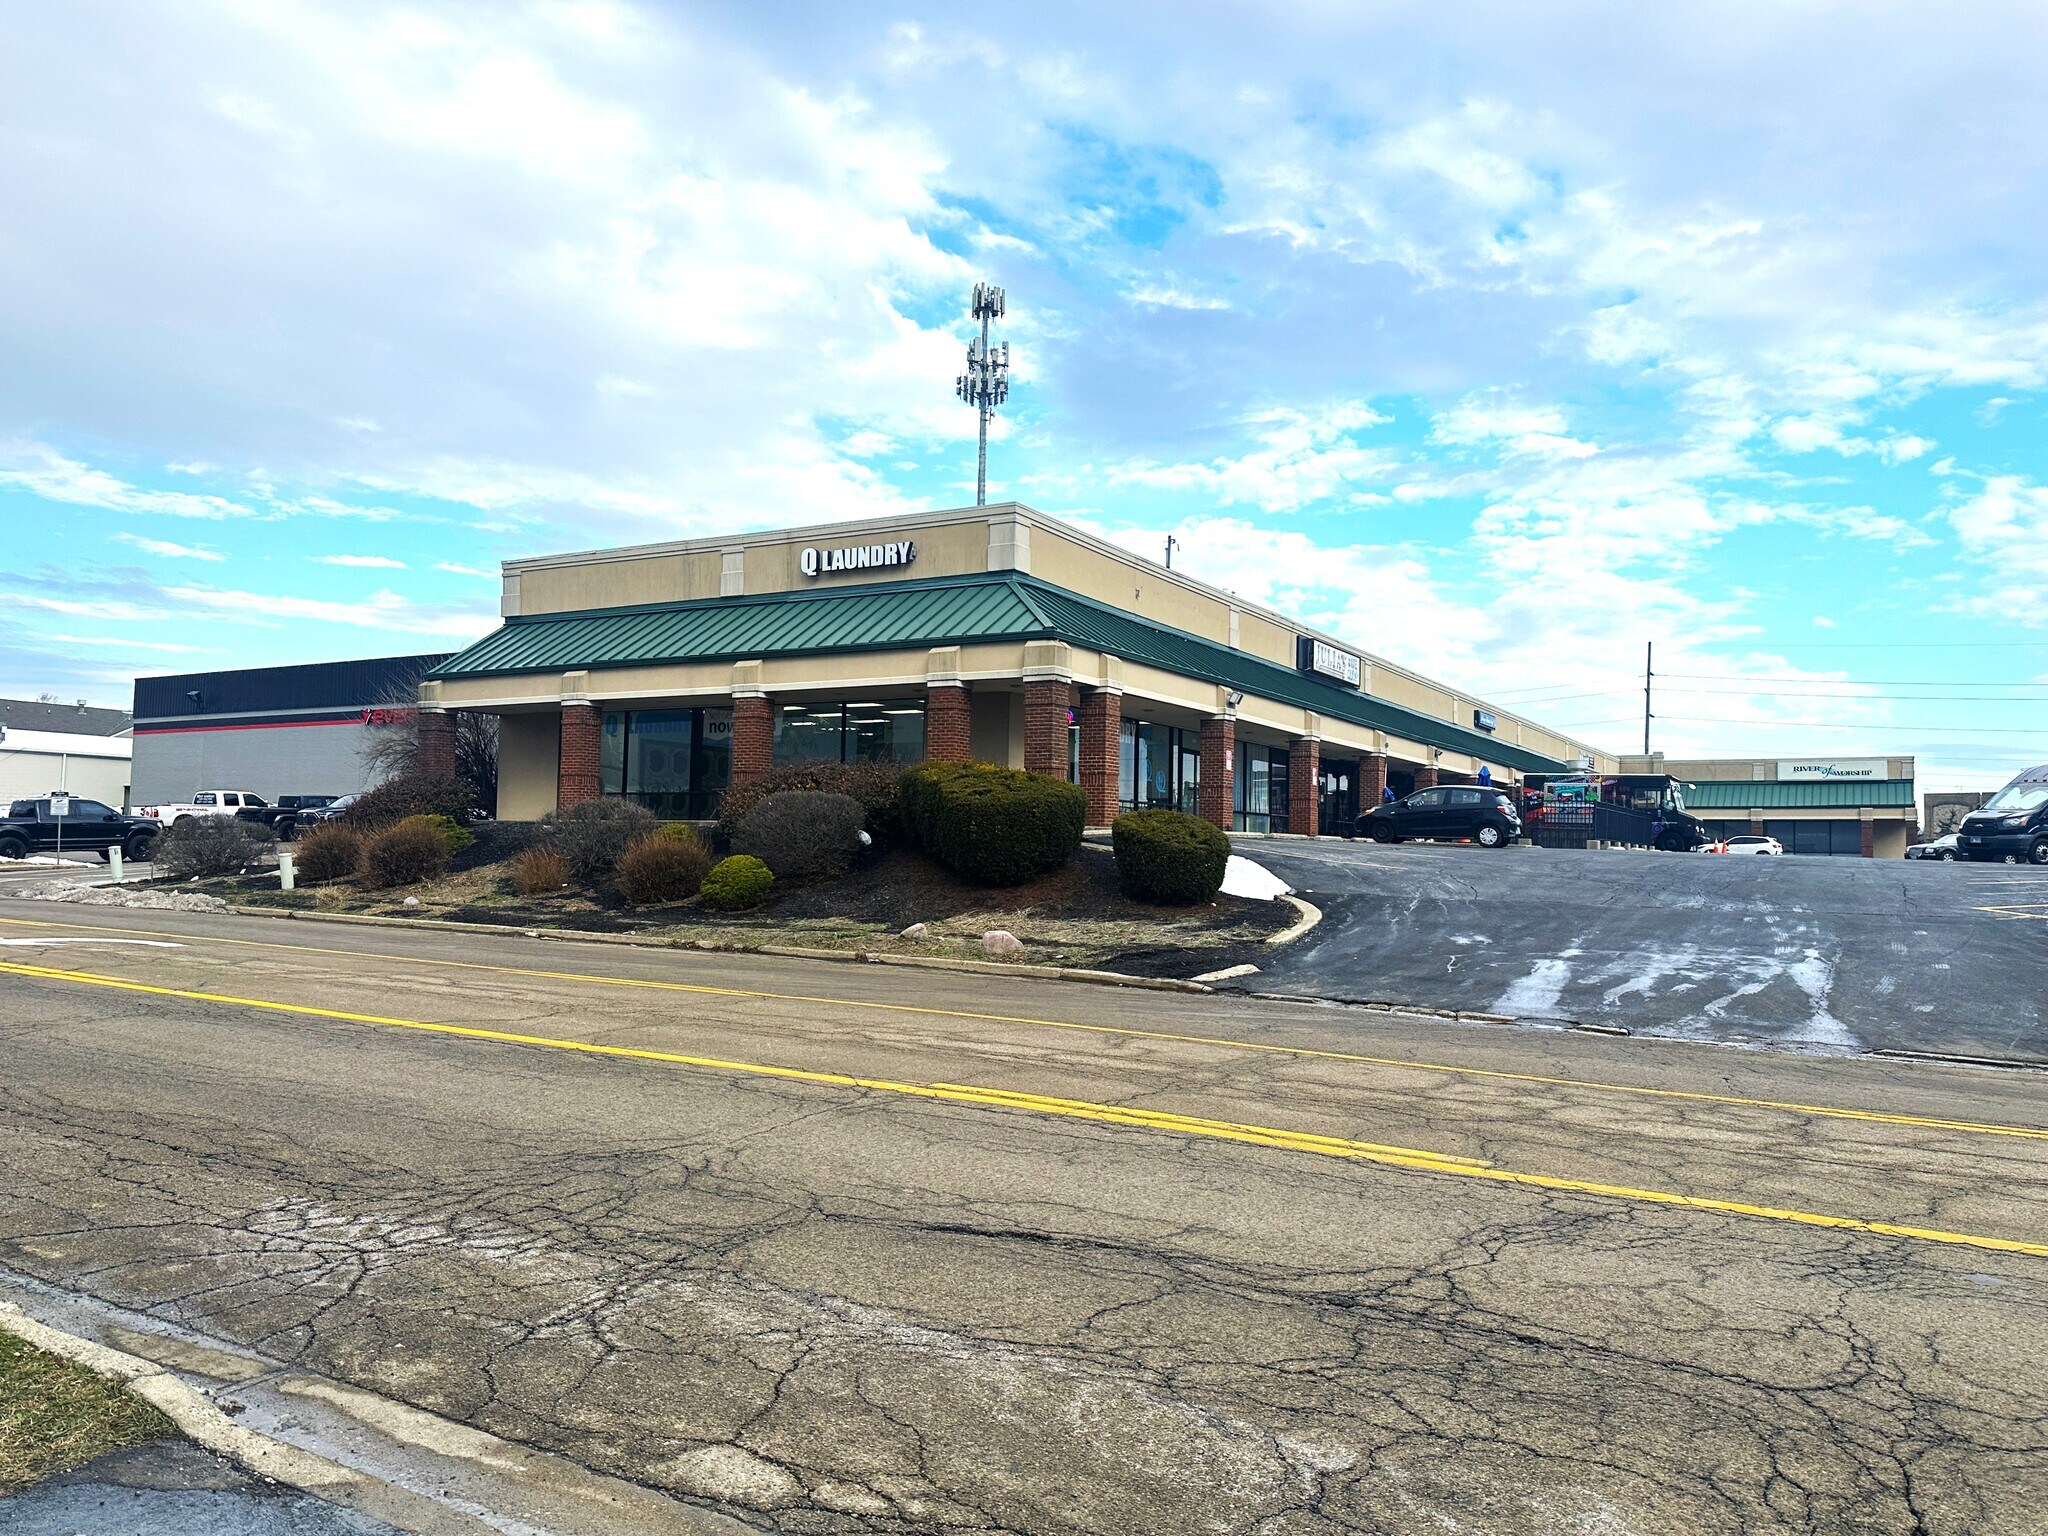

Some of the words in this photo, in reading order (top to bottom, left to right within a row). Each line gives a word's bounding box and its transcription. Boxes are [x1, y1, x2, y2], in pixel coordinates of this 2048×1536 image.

[800, 547, 817, 576] Q
[821, 541, 911, 572] LAUNDRY
[1793, 765, 1821, 773] RIVER
[1821, 764, 1836, 778] of
[1833, 769, 1873, 777] WORSHIP
